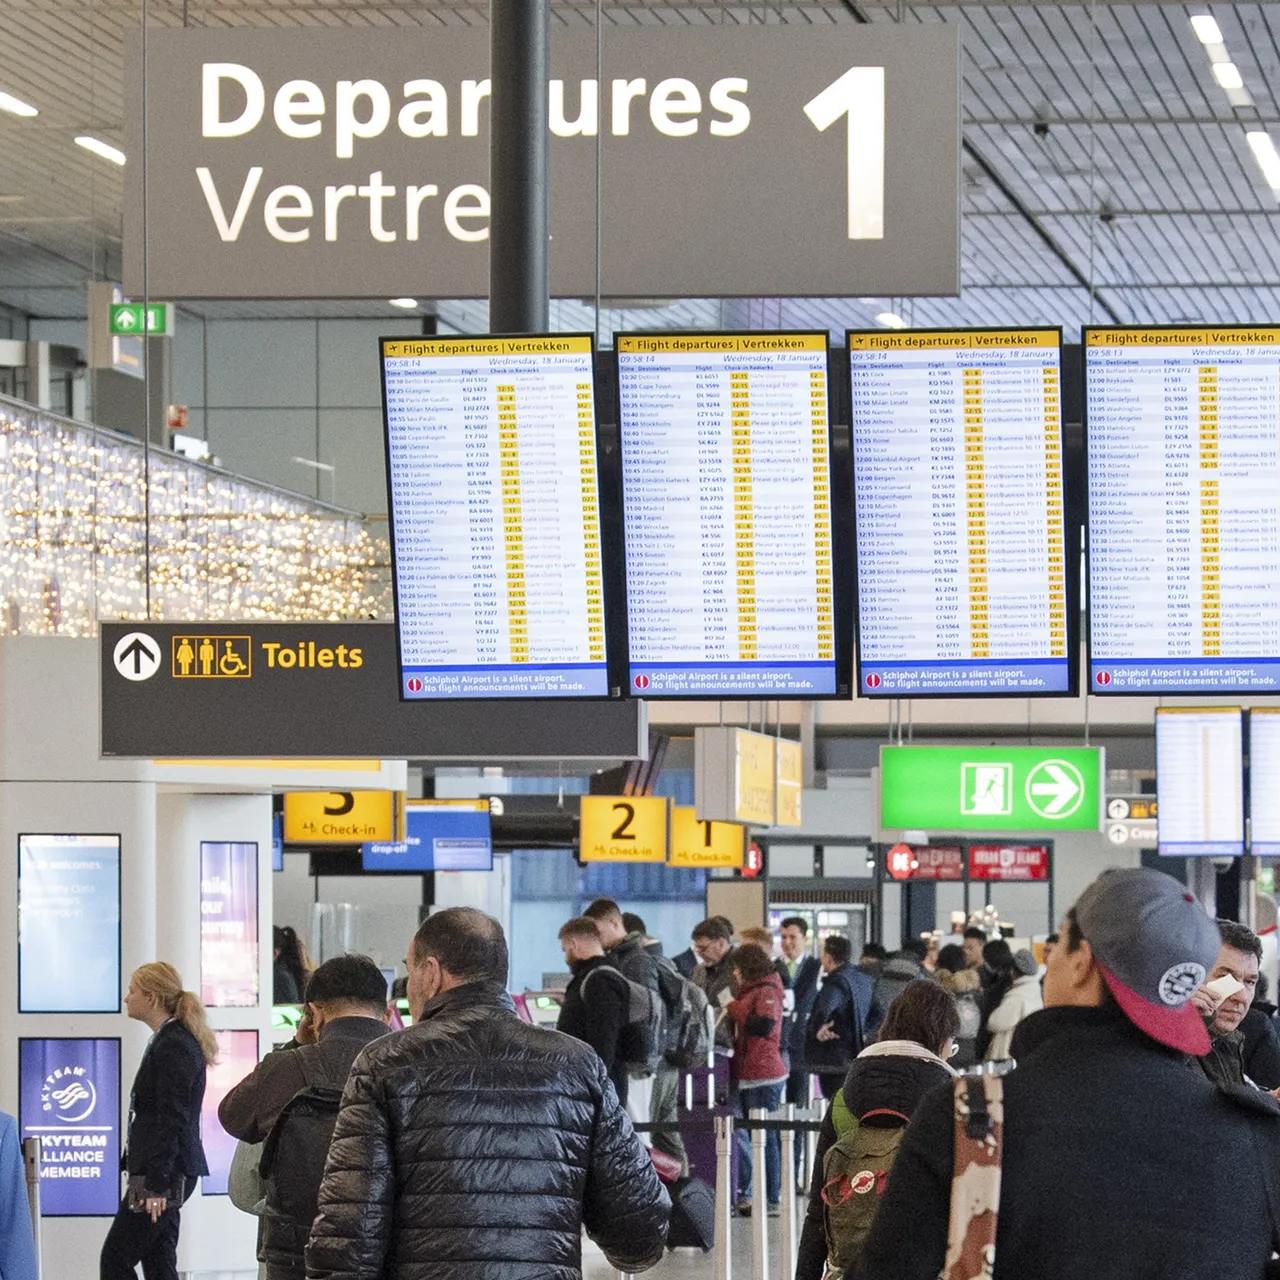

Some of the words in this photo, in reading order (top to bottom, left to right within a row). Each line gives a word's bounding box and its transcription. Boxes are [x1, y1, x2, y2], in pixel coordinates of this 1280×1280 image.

[202, 62, 750, 158] Deparures
[803, 67, 884, 239] 1
[196, 167, 491, 243] Vertre
[870, 337, 902, 347] Flight
[905, 336, 965, 346] departures
[975, 336, 1037, 345] Vertrekken
[1106, 334, 1138, 345] Flight
[1141, 333, 1202, 344] departures
[1212, 333, 1274, 343] Vertrekken
[403, 345, 435, 355] Flight
[438, 343, 498, 354] departures
[508, 342, 569, 351] Vertrekken
[638, 340, 669, 351] Flight
[672, 340, 733, 350] departures
[743, 340, 804, 349] Vertrekken
[1192, 348, 1243, 357] Wednesday,
[489, 357, 539, 366] Wednesday,
[723, 354, 774, 363] Wednesday,
[788, 354, 820, 363] January
[262, 642, 364, 669] Toilets
[424, 675, 459, 684] Schiphol
[461, 675, 491, 684] Airport
[509, 675, 532, 683] silent
[534, 674, 565, 684] airport.
[883, 671, 918, 680] Schiphol
[920, 671, 950, 680] Airport
[969, 670, 992, 679] silent
[994, 670, 1025, 679] airport.
[425, 684, 437, 692] No
[439, 683, 459, 693] flight
[464, 683, 526, 692] announcements
[548, 682, 558, 690] be
[560, 682, 585, 690] made.
[898, 679, 918, 689] flight
[1007, 678, 1018, 686] be
[1020, 678, 1046, 686] made.
[610, 802, 636, 840] 2
[322, 824, 376, 835] Check-in
[371, 844, 407, 854] drop-off
[610, 844, 652, 856] Check-in
[692, 853, 731, 861] Check-in
[41, 1067, 84, 1111] SKYTEAM
[32, 1135, 107, 1147] KYTEAM
[41, 1151, 104, 1162] LLIANCE
